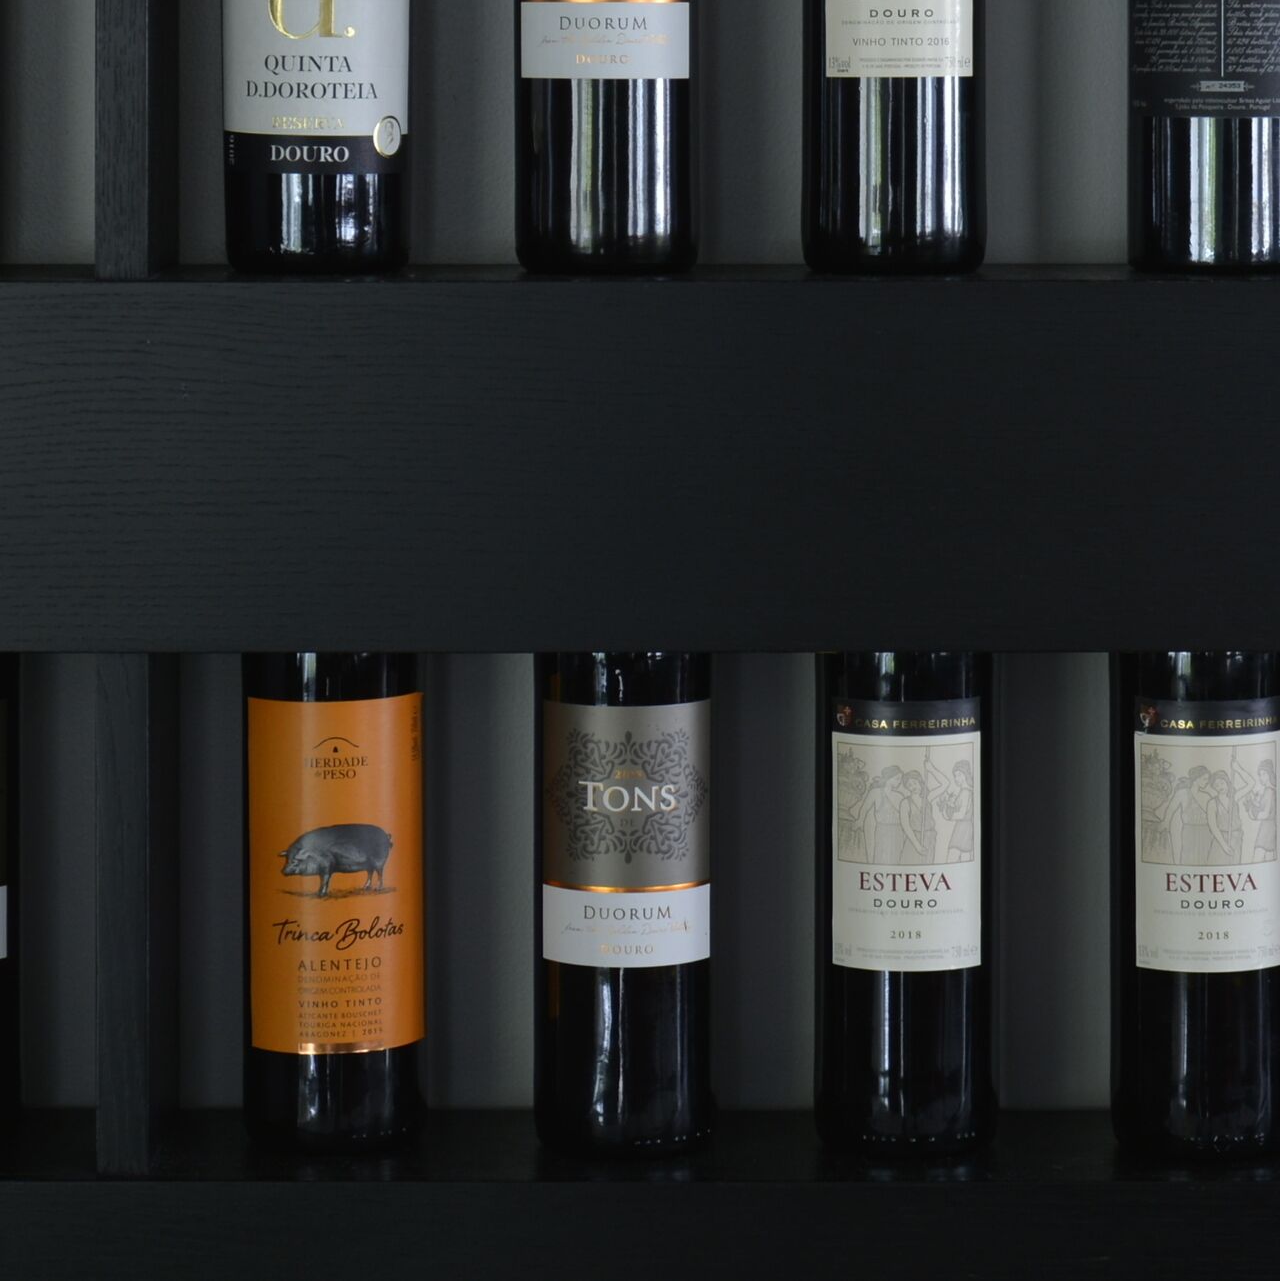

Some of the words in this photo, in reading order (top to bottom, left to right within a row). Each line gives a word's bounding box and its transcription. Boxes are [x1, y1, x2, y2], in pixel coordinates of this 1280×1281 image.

[869, 9, 934, 18] DOURO
[559, 16, 648, 31] DUORUM
[852, 37, 886, 47] VINHO
[891, 37, 924, 47] TINTO
[264, 54, 353, 77] QUINTA
[246, 80, 379, 100] D.DOROTEIA
[270, 144, 350, 163] DOURO
[855, 719, 888, 729] CASA
[893, 716, 976, 729] FERREIRINHA
[1160, 719, 1194, 729] CASA
[322, 767, 357, 780] PESO
[578, 780, 678, 812] TONS
[859, 871, 952, 892] ESTEVA
[1165, 872, 1258, 893] ESTEVA
[873, 898, 938, 909] DOURO
[1180, 898, 1245, 910] DOURO
[583, 905, 672, 921] DUORUM
[272, 917, 333, 946] Trinca
[334, 915, 405, 950] Bolotas
[890, 930, 923, 940] 2018
[1198, 931, 1230, 940] 2018
[297, 956, 382, 972] ALENTEJO
[298, 999, 339, 1009] VINHO
[345, 997, 382, 1008] TINTO
